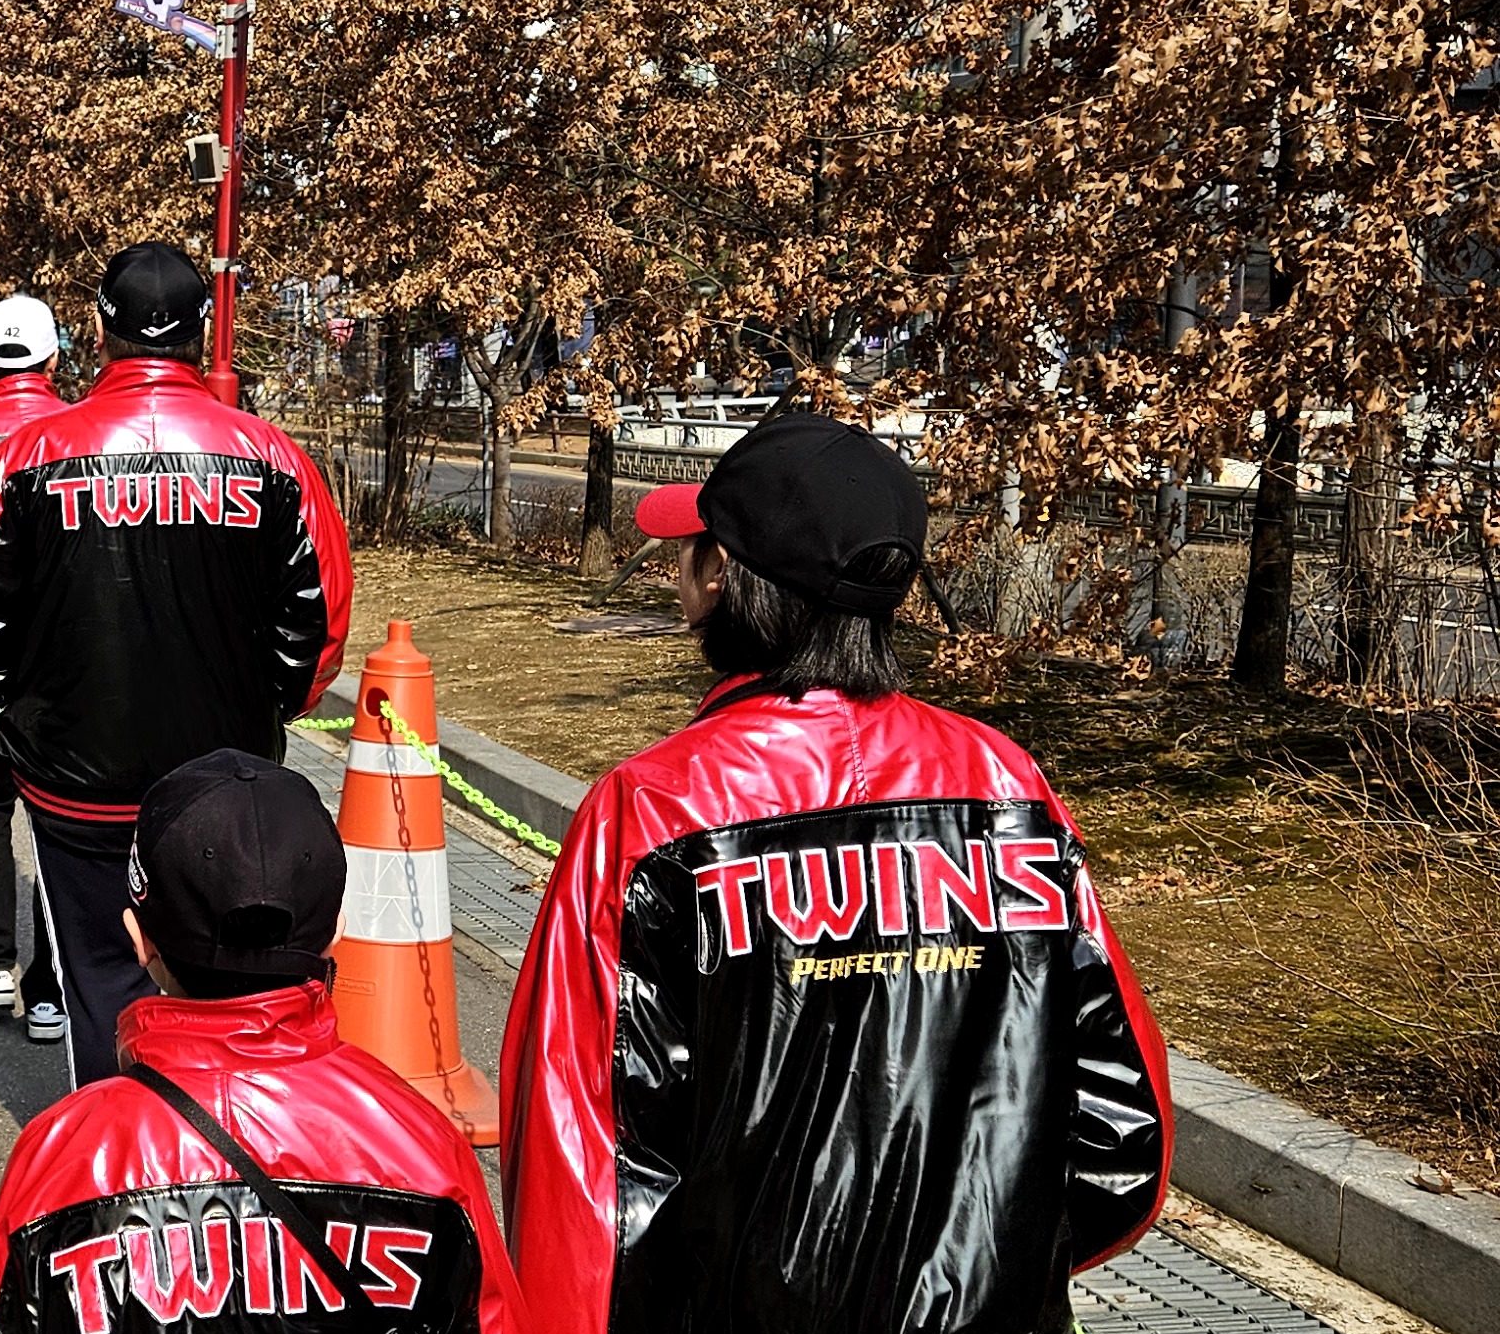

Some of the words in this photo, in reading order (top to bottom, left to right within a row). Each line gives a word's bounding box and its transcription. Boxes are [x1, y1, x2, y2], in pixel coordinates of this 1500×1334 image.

[4, 327, 20, 337] 42
[46, 473, 263, 531] TWINS
[693, 837, 1069, 958] TWINS
[790, 951, 911, 984] PERFECT
[914, 945, 986, 974] ONE
